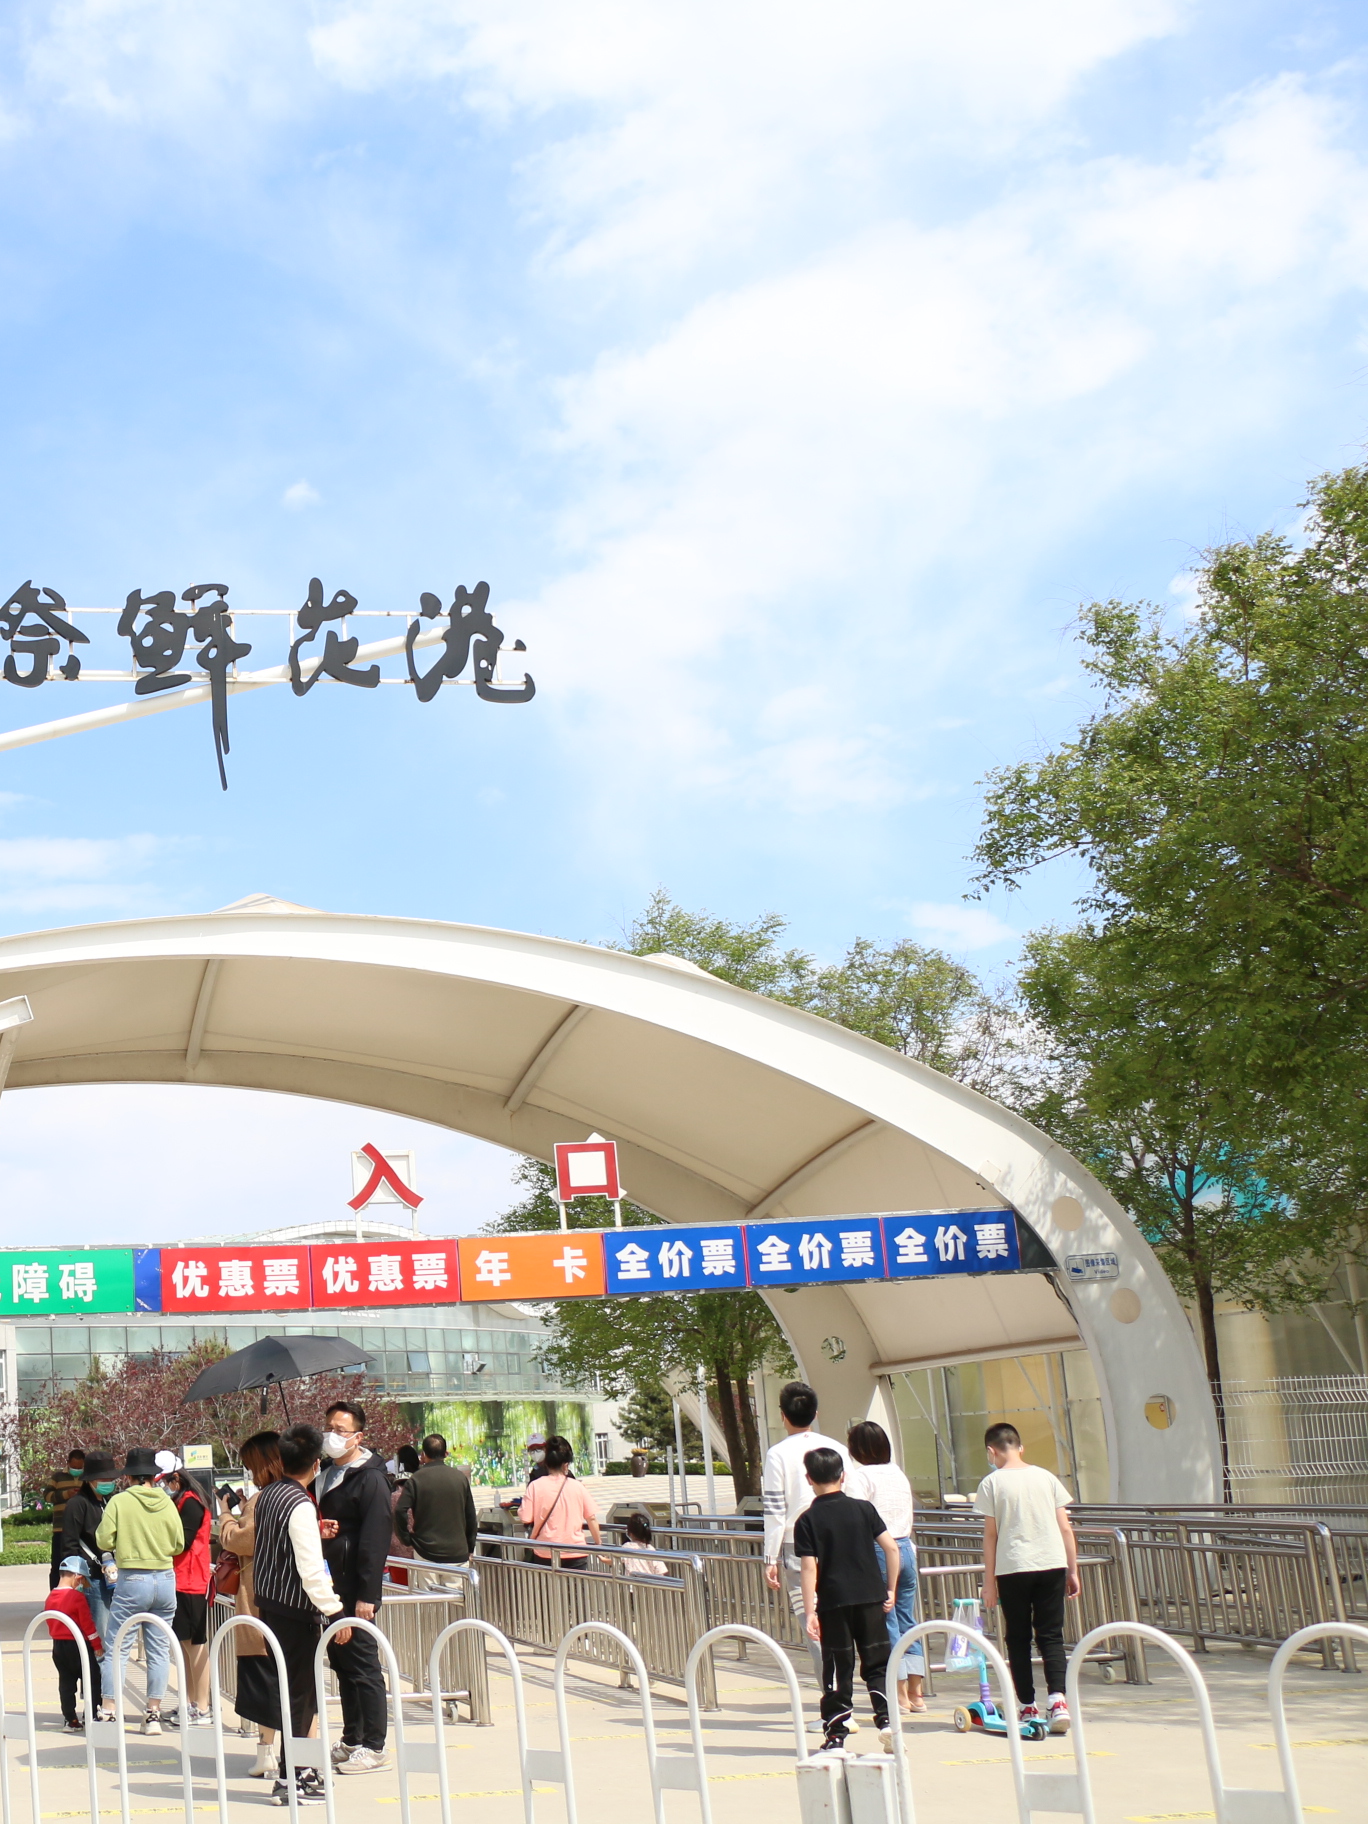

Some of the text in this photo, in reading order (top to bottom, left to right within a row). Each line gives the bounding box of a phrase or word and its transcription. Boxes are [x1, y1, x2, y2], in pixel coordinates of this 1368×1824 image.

[347, 1142, 620, 1211] 入口
[615, 1238, 736, 1280] 全价票
[756, 1230, 875, 1272] 全价票
[893, 1223, 1008, 1264] 全价票
[172, 1258, 300, 1298] 优惠票
[322, 1252, 448, 1293] 优惠票
[475, 1246, 588, 1287] 年卡
